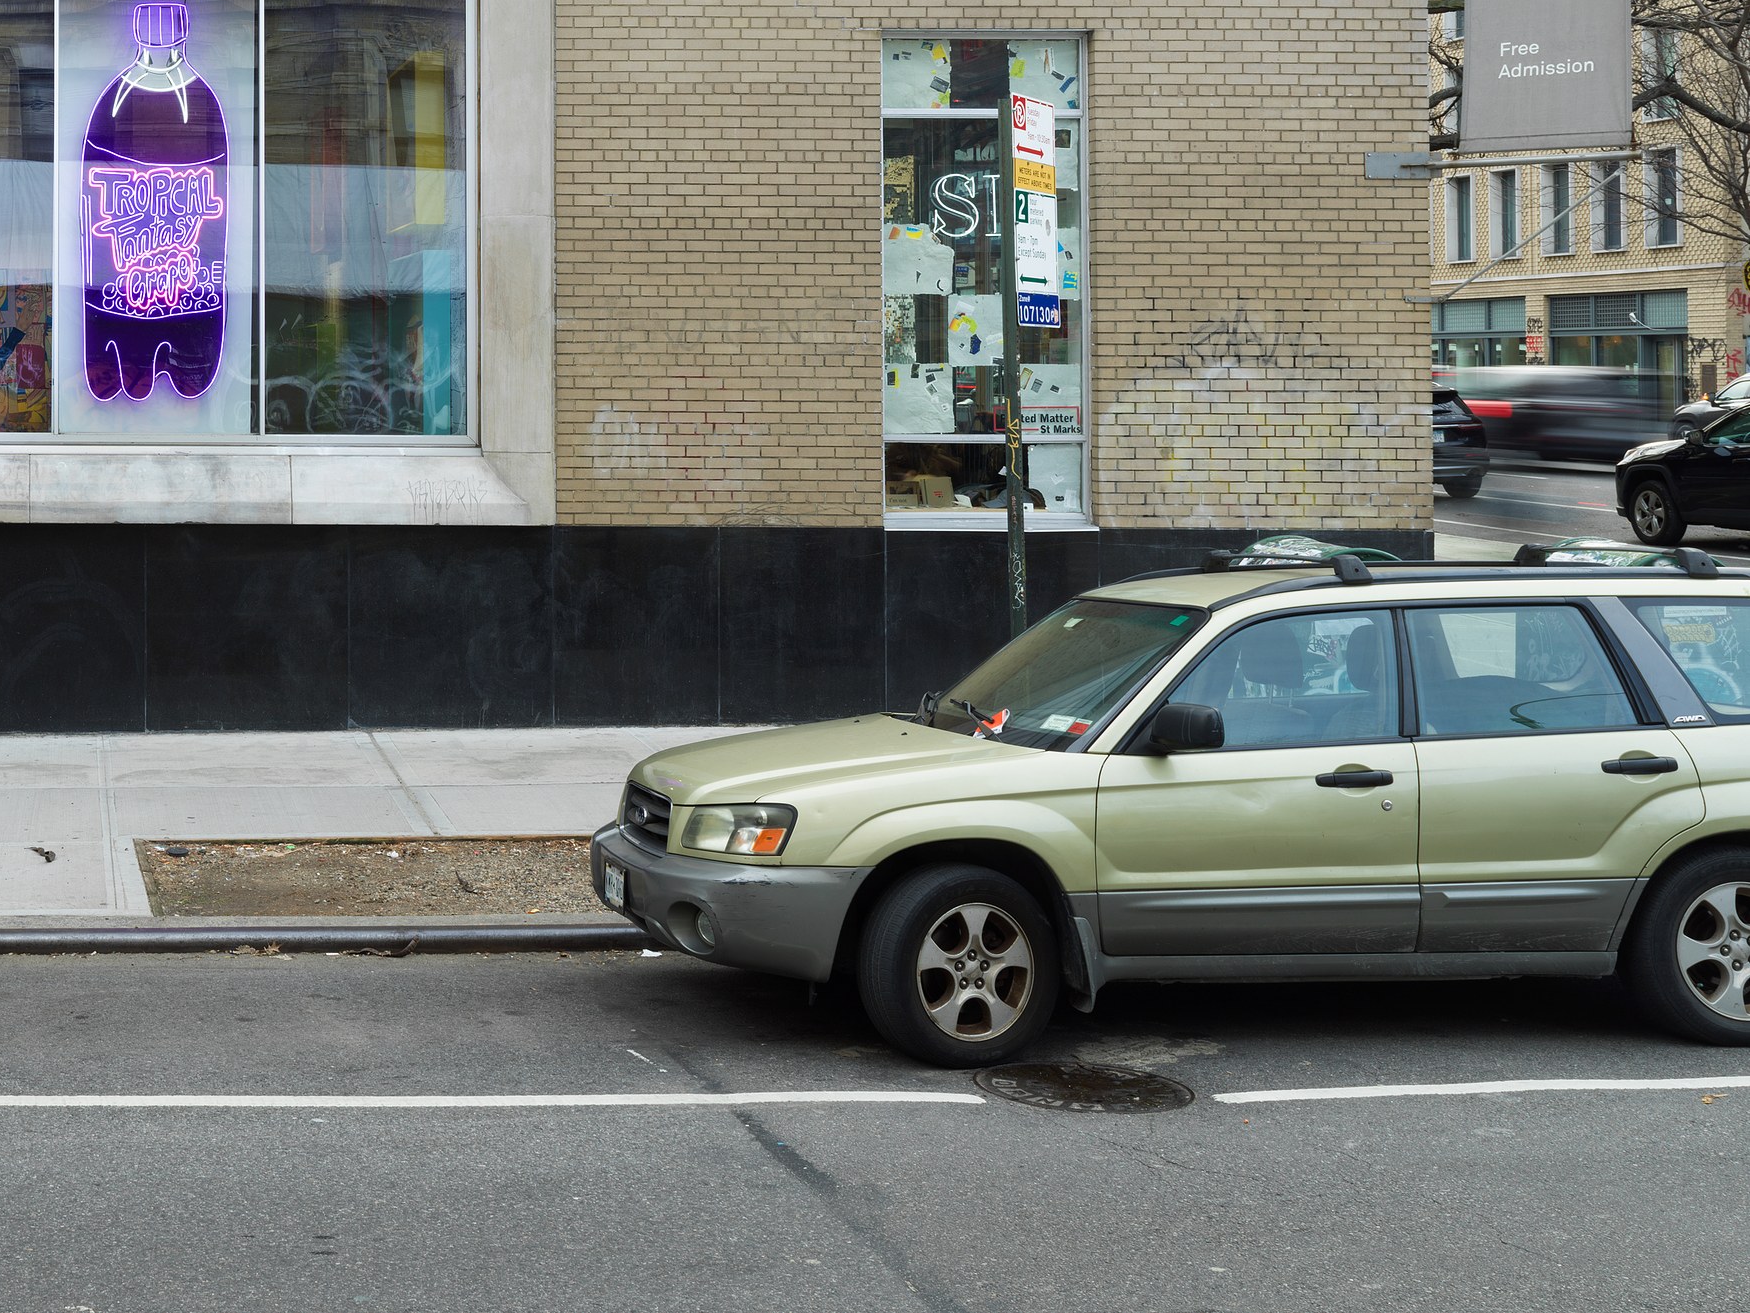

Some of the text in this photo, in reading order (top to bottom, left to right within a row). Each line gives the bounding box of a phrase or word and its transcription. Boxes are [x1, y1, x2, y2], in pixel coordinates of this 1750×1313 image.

[1500, 41, 1540, 57] Free
[1498, 59, 1595, 79] Admission
[1019, 167, 1032, 176] METERS
[1018, 177, 1052, 190] EFFECT ABOVE TIMES
[91, 169, 222, 218] TROPICAL
[933, 173, 1001, 237] SI
[1018, 193, 1026, 220] 2
[1018, 246, 1047, 261] Except Sunday
[128, 255, 193, 308] Grape
[1020, 305, 1050, 323] 107130
[1000, 413, 1074, 423] Pted Matter
[1040, 425, 1082, 434] St Marks
[1673, 714, 1707, 724] AWD
